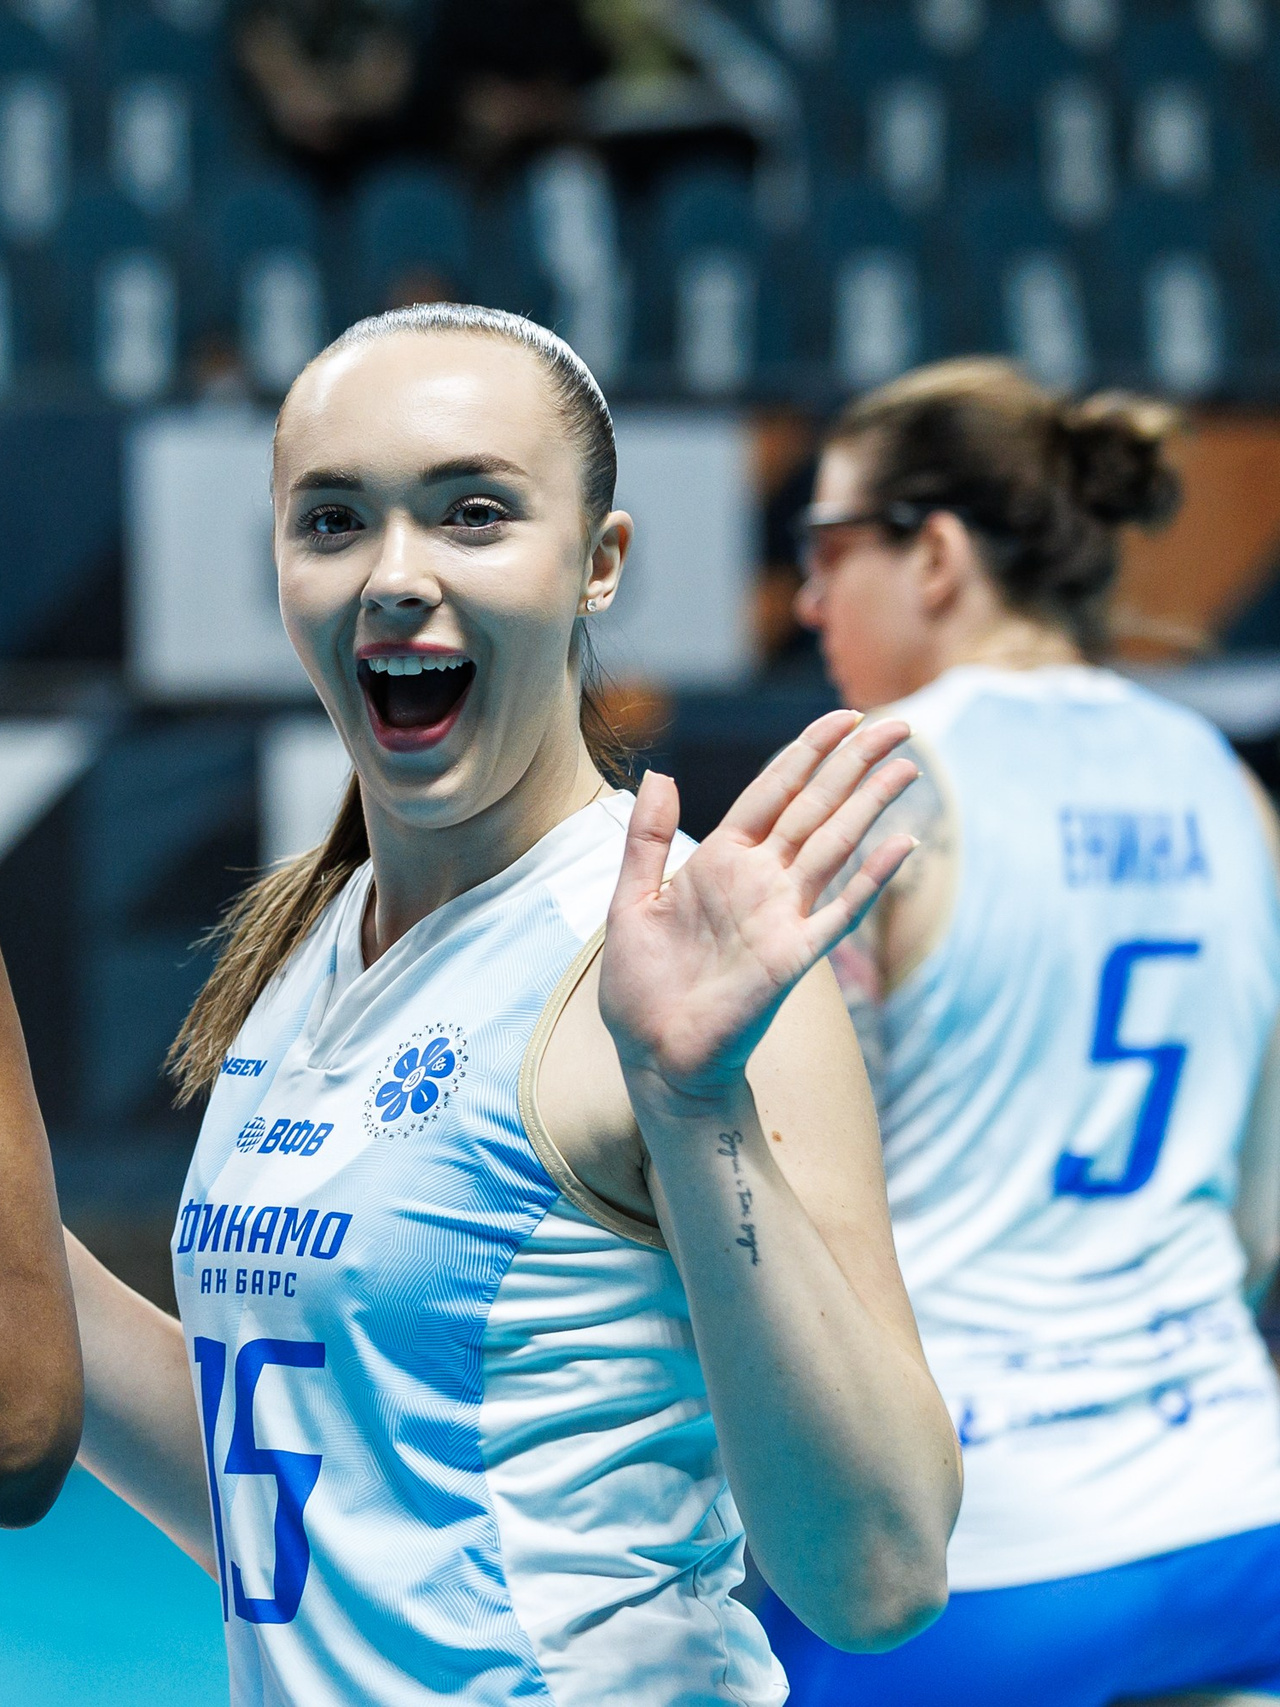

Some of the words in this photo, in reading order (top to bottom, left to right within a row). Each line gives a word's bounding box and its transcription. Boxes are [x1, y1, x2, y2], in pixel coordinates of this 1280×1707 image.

[1052, 938, 1202, 1199] 5
[256, 1118, 334, 1157] ВФВ
[177, 1198, 354, 1261] ДИНАМО
[200, 1268, 228, 1295] АК
[235, 1268, 298, 1299] БАРС
[194, 1335, 326, 1625] 15
